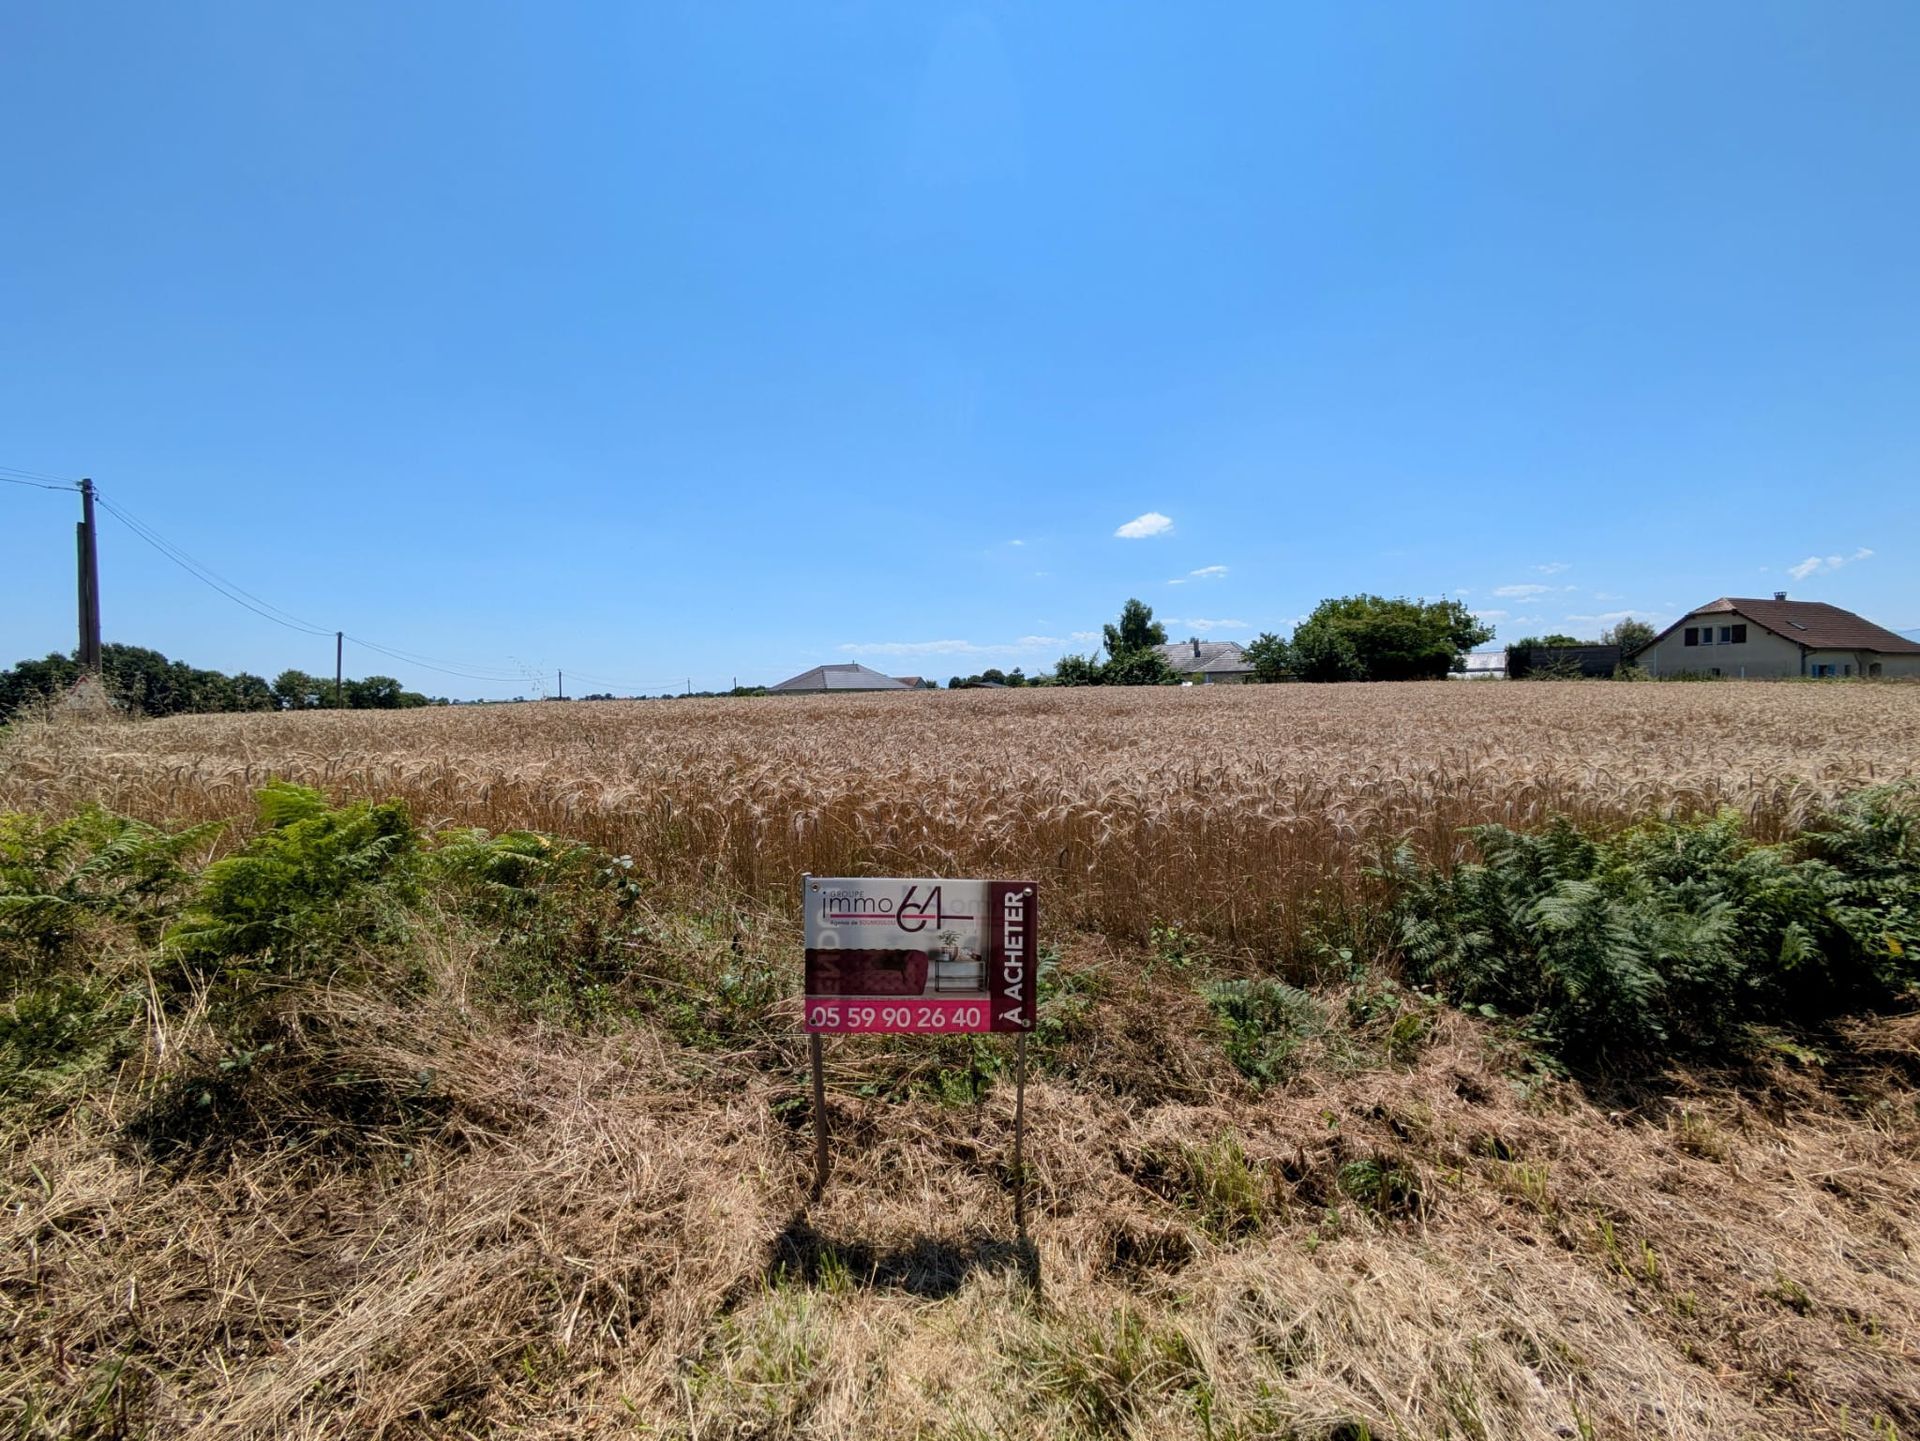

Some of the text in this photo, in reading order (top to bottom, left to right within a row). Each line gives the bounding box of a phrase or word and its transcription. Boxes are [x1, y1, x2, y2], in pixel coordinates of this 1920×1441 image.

[823, 885, 942, 933] immo 64
[830, 890, 865, 898] GROUPE
[999, 891, 1024, 1026] À ACHETER
[811, 1006, 981, 1028] 05 59 90 26 40
